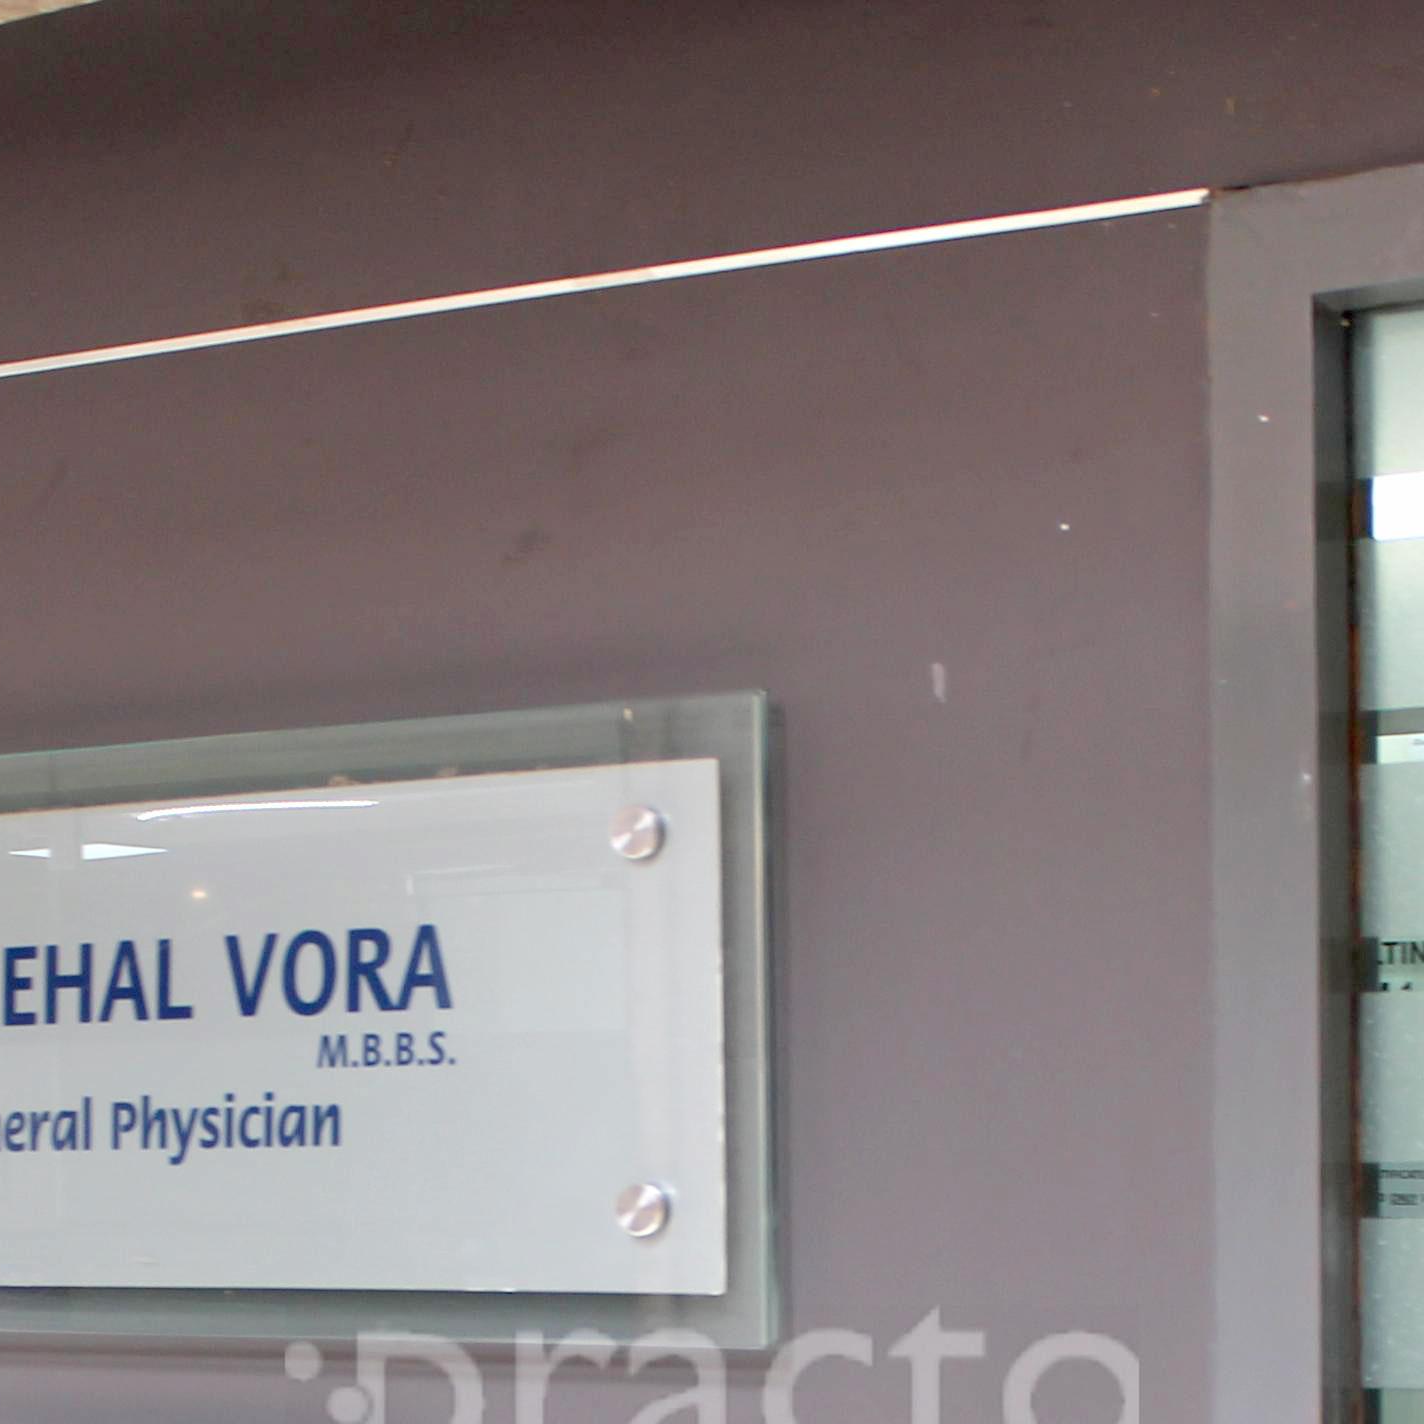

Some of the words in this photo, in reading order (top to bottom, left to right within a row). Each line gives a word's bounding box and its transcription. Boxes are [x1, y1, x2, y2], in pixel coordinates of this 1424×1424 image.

[222, 923, 453, 1018] VORA
[317, 1030, 457, 1069] M.B.B.S.
[110, 1091, 342, 1166] Physician
